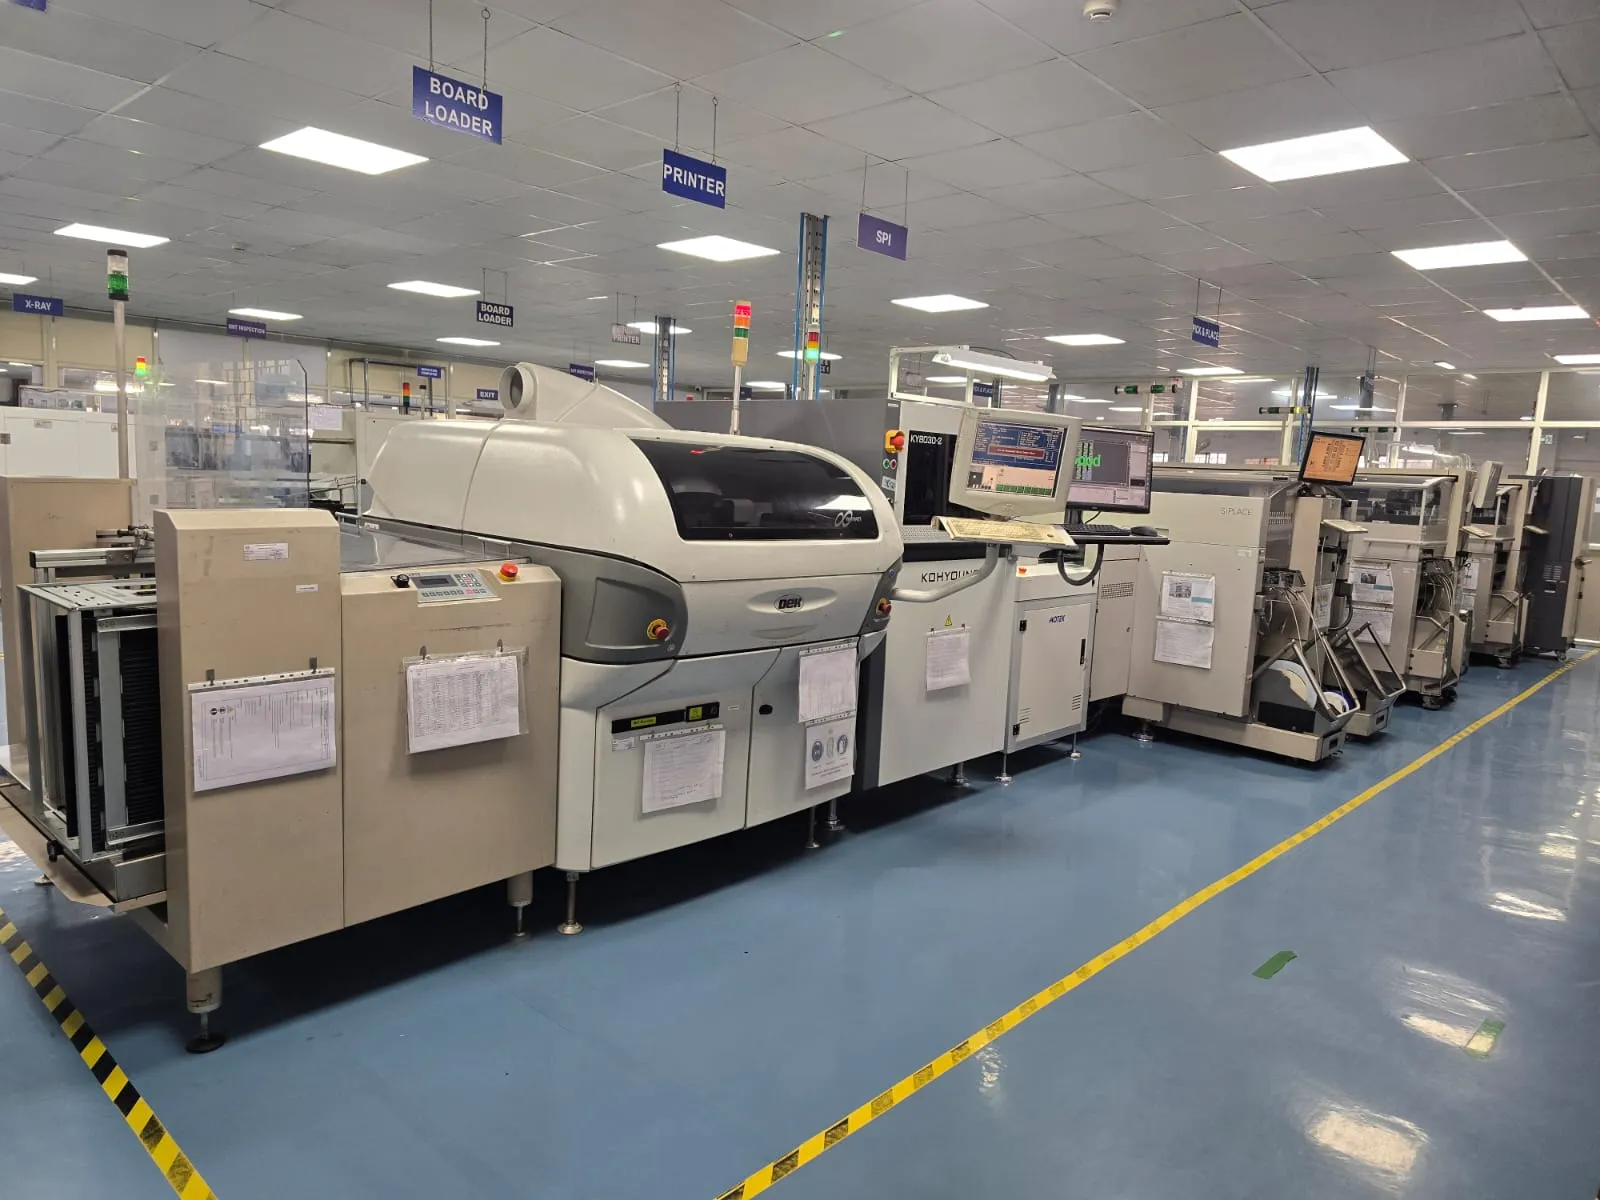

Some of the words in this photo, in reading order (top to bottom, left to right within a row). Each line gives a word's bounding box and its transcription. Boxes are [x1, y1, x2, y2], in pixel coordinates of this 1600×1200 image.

[430, 77, 489, 111] BOARD
[425, 100, 493, 136] LOADER
[663, 163, 725, 197] PRINTER
[875, 229, 892, 246] SPI
[25, 299, 52, 311] X-RAY
[481, 302, 510, 316] BOARD
[478, 312, 512, 326] LOADER
[480, 390, 496, 399] EXIT
[910, 433, 943, 446] KY8030-2
